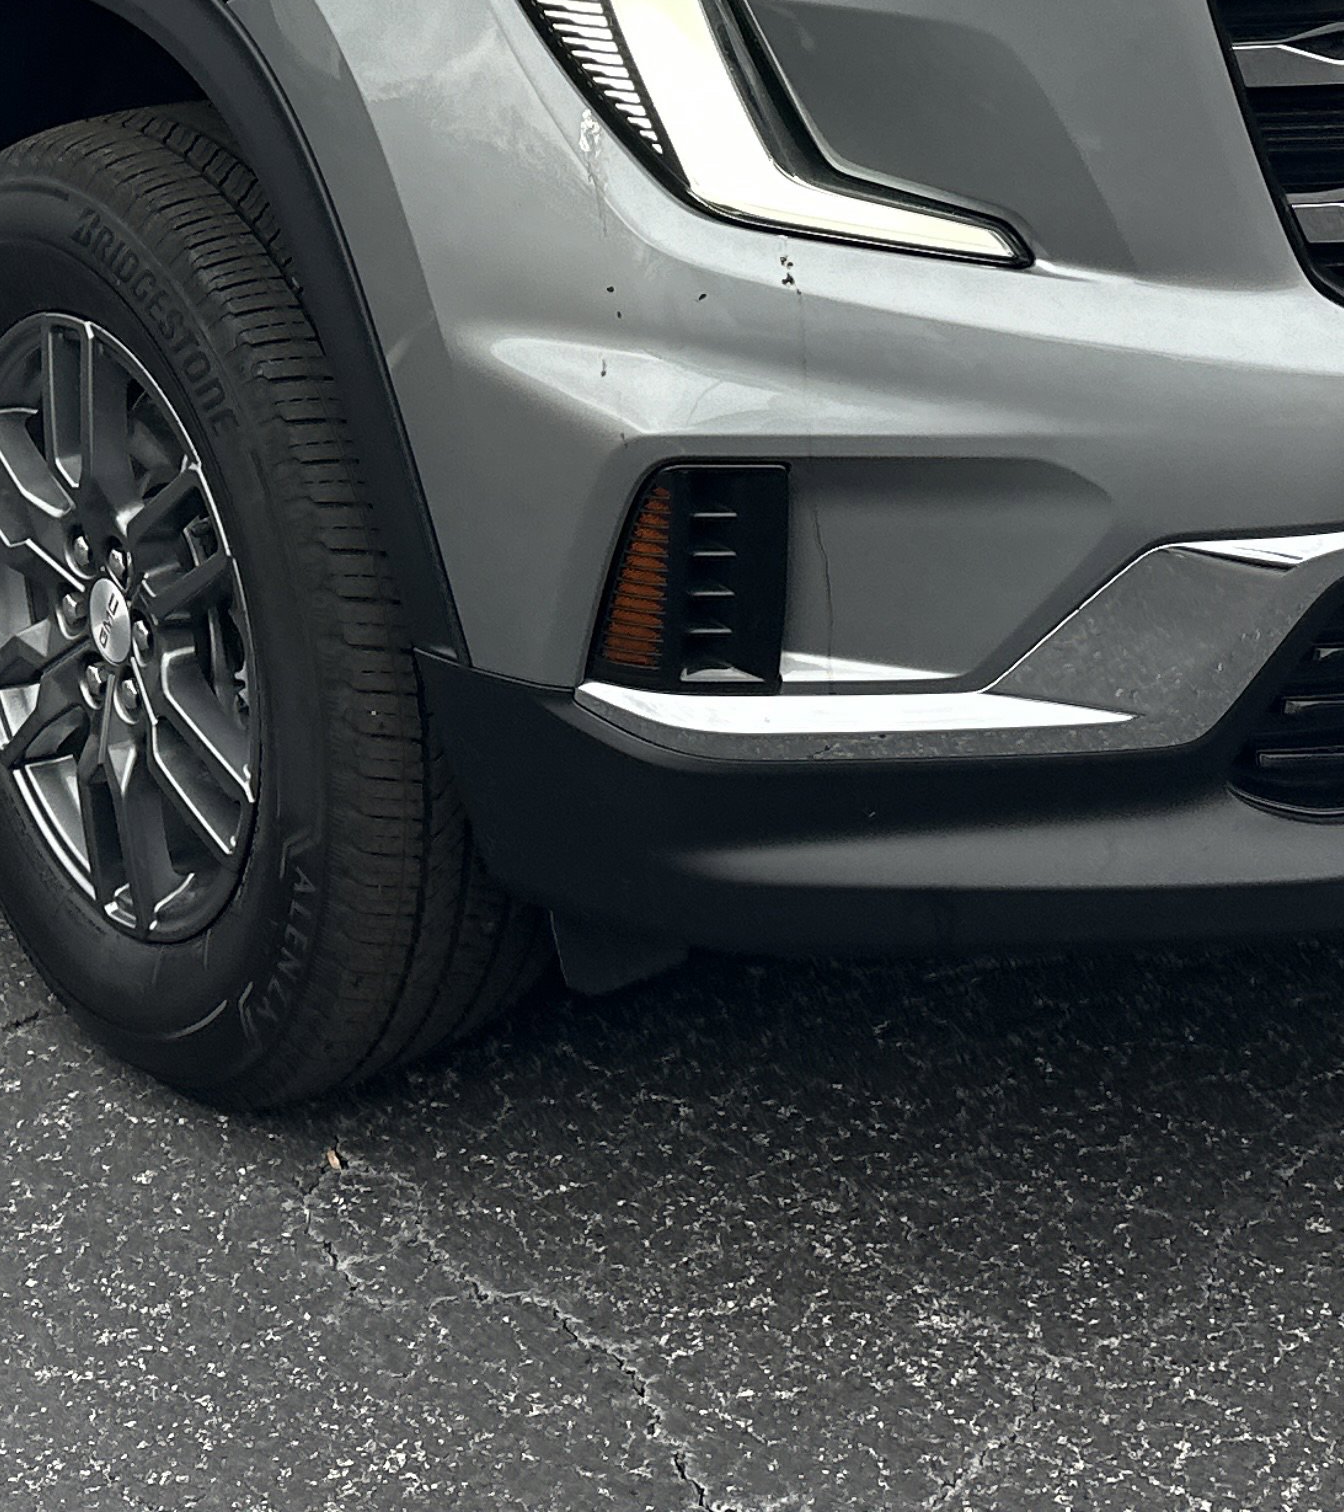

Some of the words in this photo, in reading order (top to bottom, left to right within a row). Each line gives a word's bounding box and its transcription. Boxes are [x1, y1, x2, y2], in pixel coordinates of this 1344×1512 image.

[71, 207, 240, 436] BRIDGESTONE
[99, 592, 119, 648] GMC
[256, 865, 316, 1023] ALENZA
